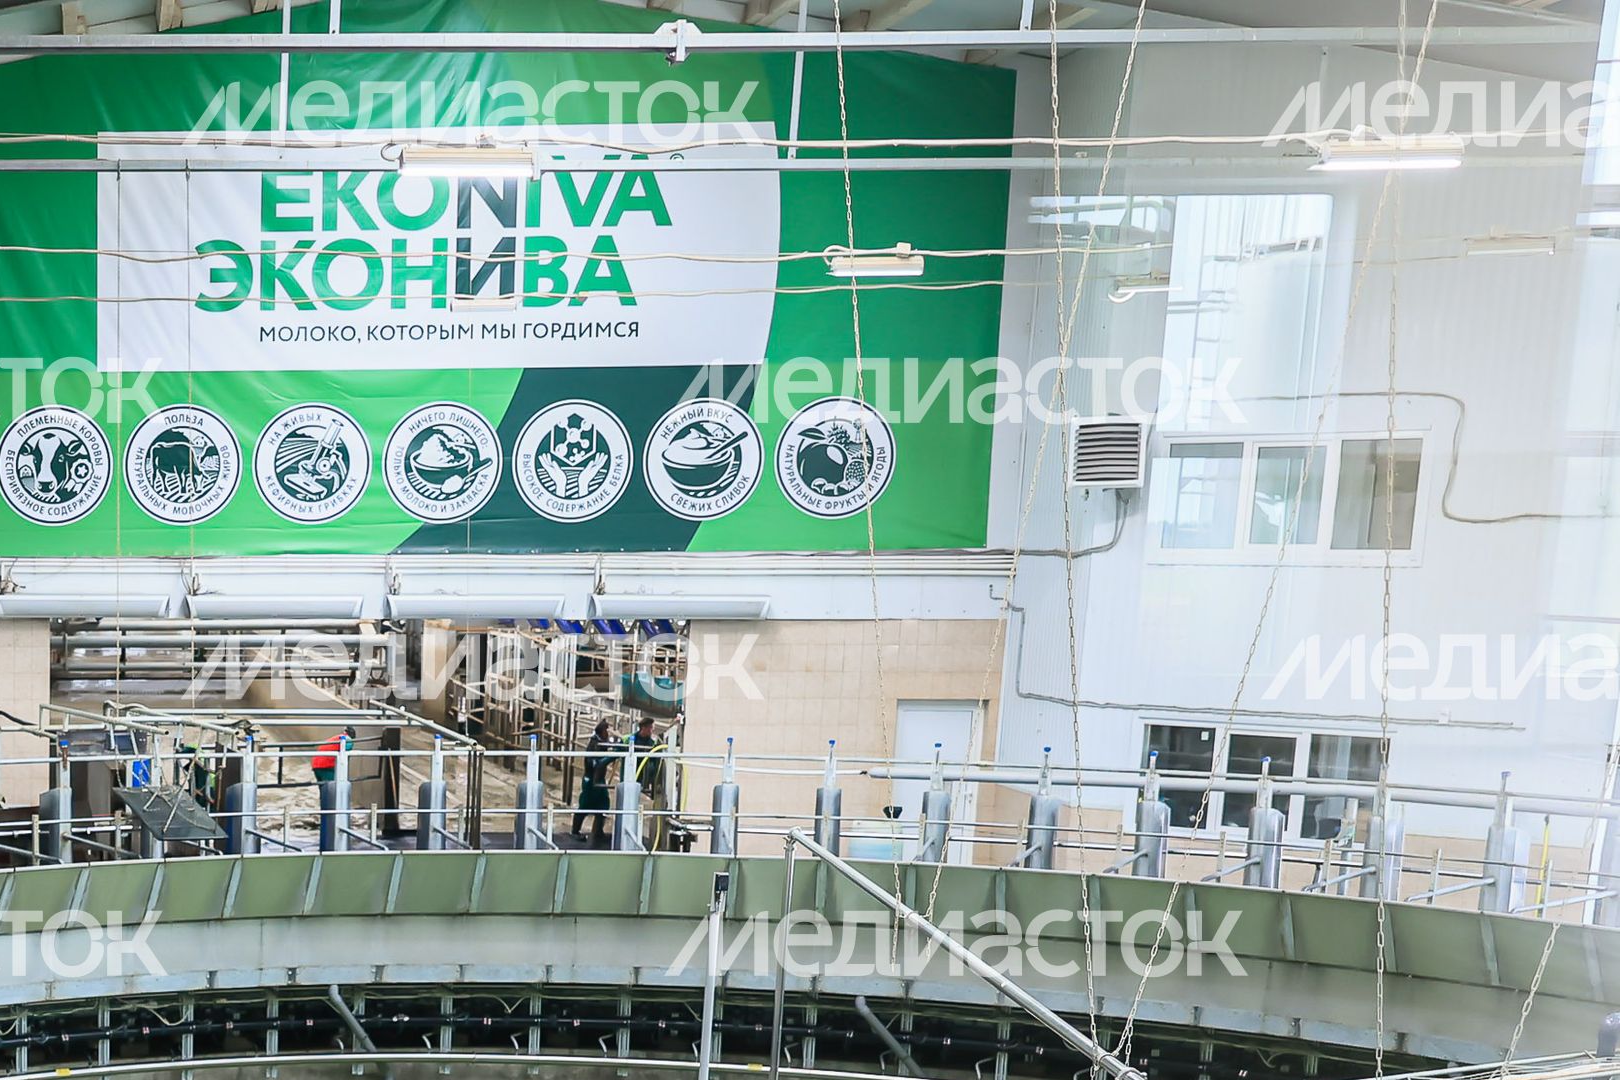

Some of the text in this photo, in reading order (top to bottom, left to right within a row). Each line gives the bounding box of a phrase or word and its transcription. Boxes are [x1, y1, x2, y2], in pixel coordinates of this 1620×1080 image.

[261, 154, 672, 232] EKONIVA
[194, 235, 638, 312] ЭКОНИВА
[259, 321, 640, 344] МОЛОКО, КОТОРЫМ МЫ ГОРДИМСЯ
[17, 415, 103, 466] ПЛЕМЕННЫЕ КОРОВЫ
[164, 413, 205, 427] ПОЛЬЗА
[269, 413, 322, 446] НА ЖИВЫХ
[409, 411, 446, 433] НИЧЕГО
[660, 406, 733, 440] НЕЖНЫЙ ВКУС
[5, 449, 102, 516] БЕСПРИВЯЗНОЕ СОДЕРЖАНИЕ
[134, 445, 231, 515] НАТУРАЛЬНЫХ МОЛОЧНЫХ ЖИРОВ
[265, 476, 357, 513] КЕФИРНЫХ ГРИБКАХ
[393, 446, 489, 513] ТОЛЬКО МОЛОКО И ЗАКВАСКА
[523, 453, 624, 513] ВЫСОКОЕ СОДЕРЖАНИЕ БЕЛКА
[670, 475, 750, 512] СВЕЖИХ СЛИВОК
[784, 444, 822, 509] НАТУРАЛЬНЫЕ
[824, 489, 867, 510] ФРУКТЫ
[871, 446, 888, 483] ЯГОДЫ
